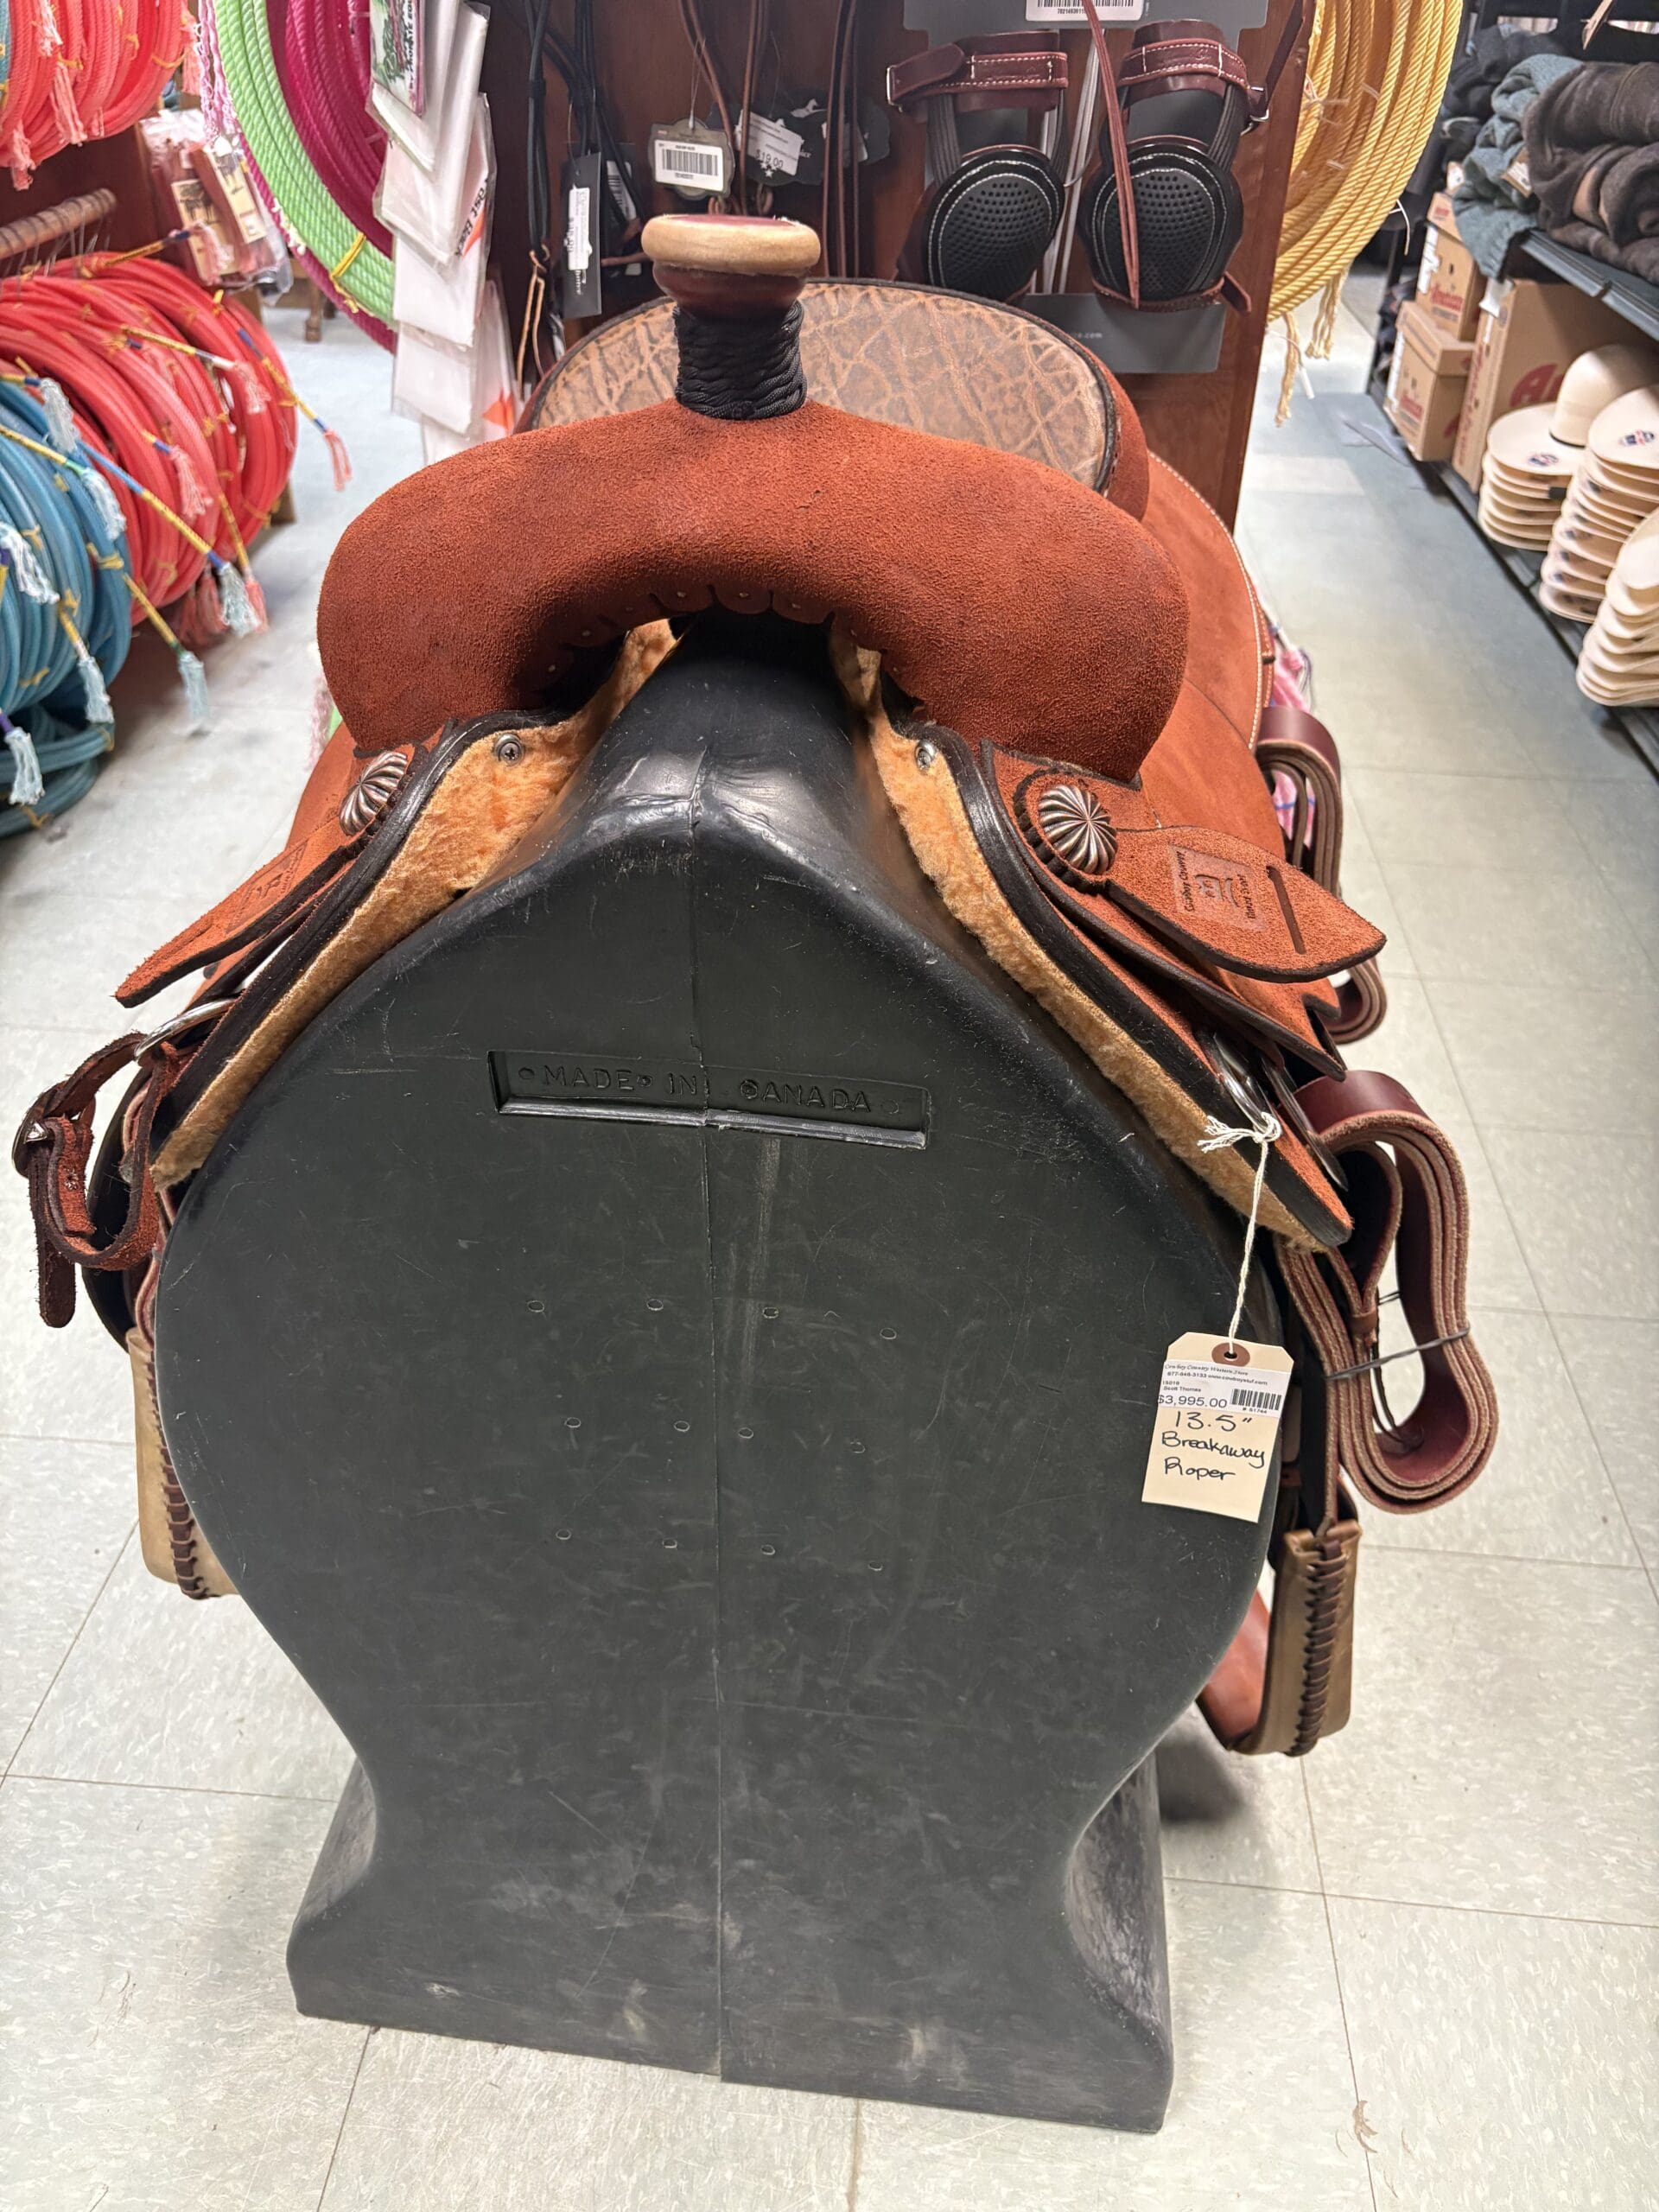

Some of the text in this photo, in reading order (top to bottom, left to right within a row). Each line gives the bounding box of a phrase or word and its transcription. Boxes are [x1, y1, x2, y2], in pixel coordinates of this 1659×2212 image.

[544, 1065, 871, 1113] MADE IN CANADA
[1158, 1394, 1228, 1408] $3,995.00
[1175, 1410, 1253, 1432] 13.5"
[1161, 1430, 1265, 1469] Breakaway
[1164, 1456, 1236, 1481] Roper
